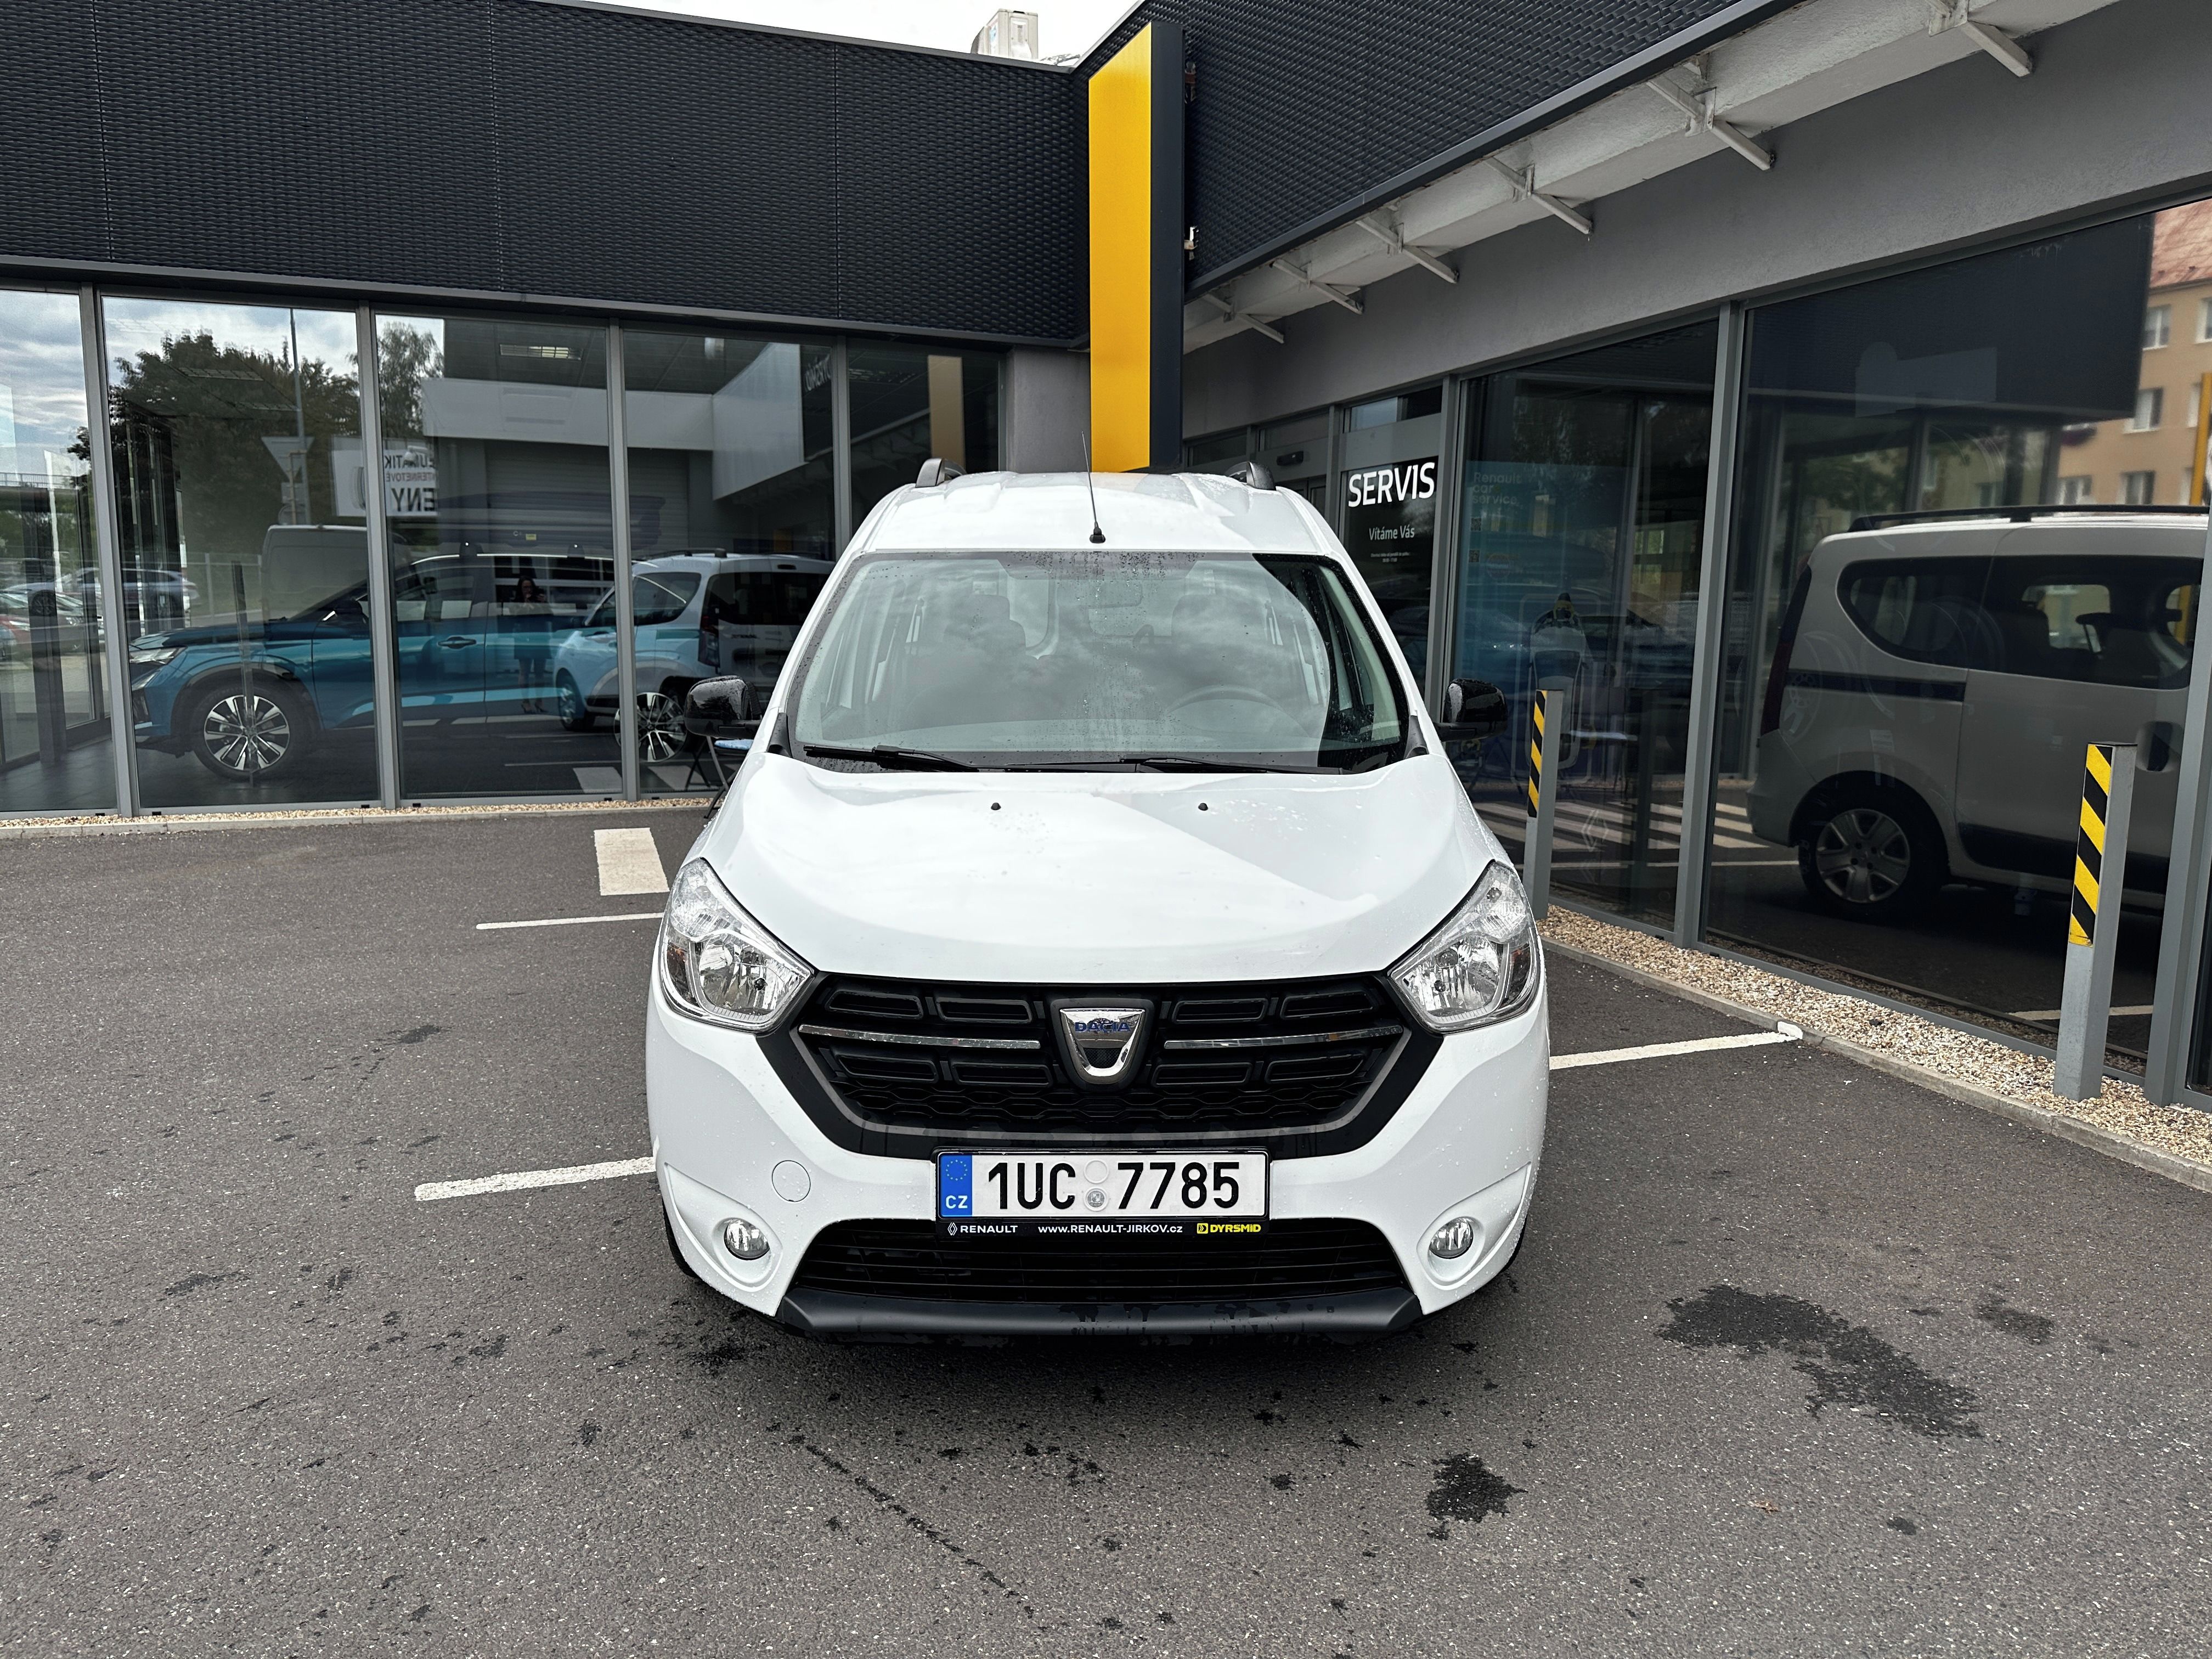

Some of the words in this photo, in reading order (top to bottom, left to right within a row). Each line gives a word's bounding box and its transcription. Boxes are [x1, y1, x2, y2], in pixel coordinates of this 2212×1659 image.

[1474, 472, 1522, 484] Renault
[1348, 462, 1436, 507] SERVIS
[1369, 526, 1398, 541] Vítáme
[1400, 524, 1415, 539] Vás
[1075, 1022, 1131, 1033] DACIA
[945, 1195, 968, 1209] CZ
[989, 1163, 1076, 1210] 1UC
[1118, 1162, 1240, 1209] 7785
[961, 1225, 1018, 1233] RENAULT
[1038, 1224, 1183, 1233] www.RENAULT-JIRKOV.cz
